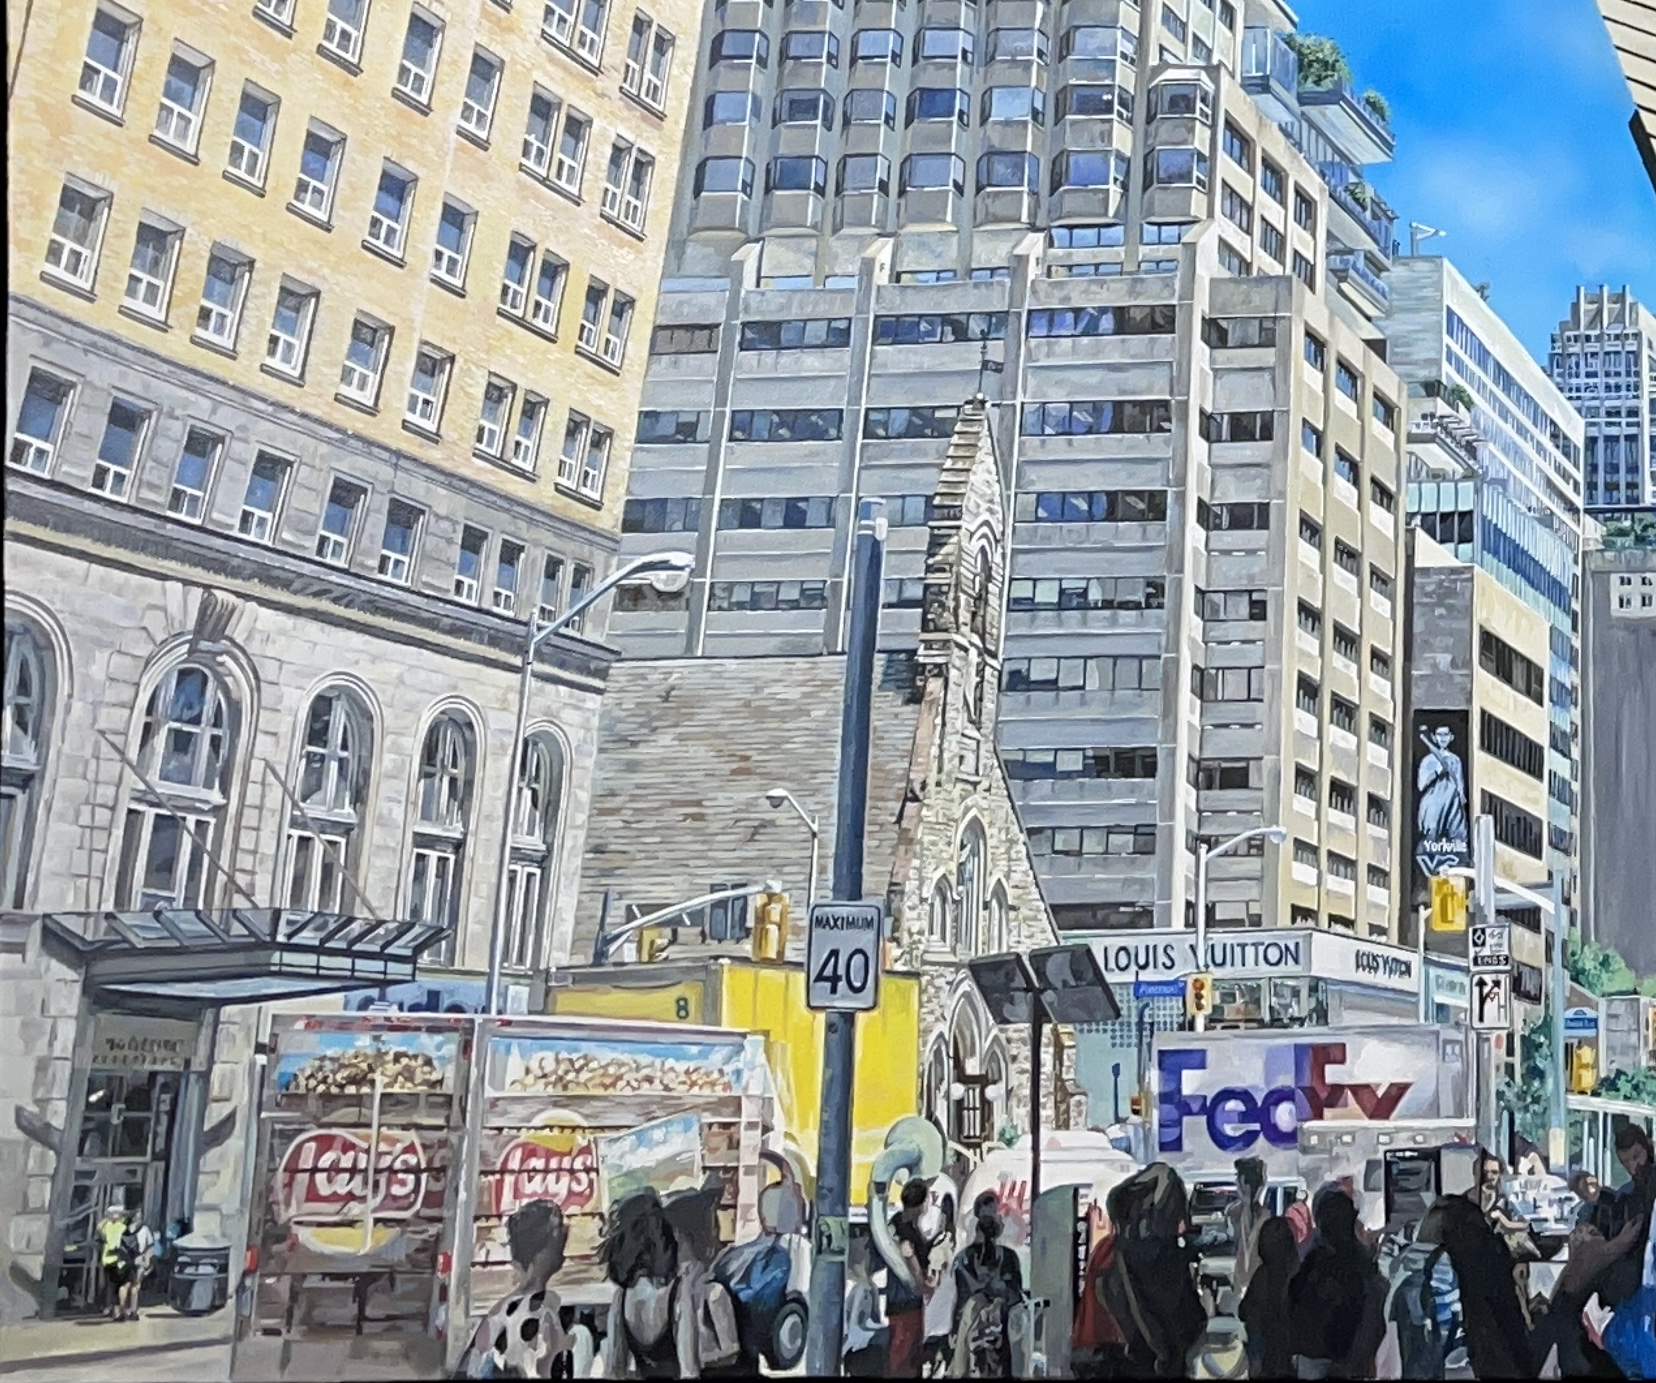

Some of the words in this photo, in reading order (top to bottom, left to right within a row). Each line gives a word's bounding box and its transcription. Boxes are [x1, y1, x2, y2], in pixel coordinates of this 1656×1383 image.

[1423, 837, 1467, 853] Yorkville
[814, 914, 875, 931] MAXIMUM
[1103, 944, 1176, 973] LOUIS
[813, 947, 870, 995] 40
